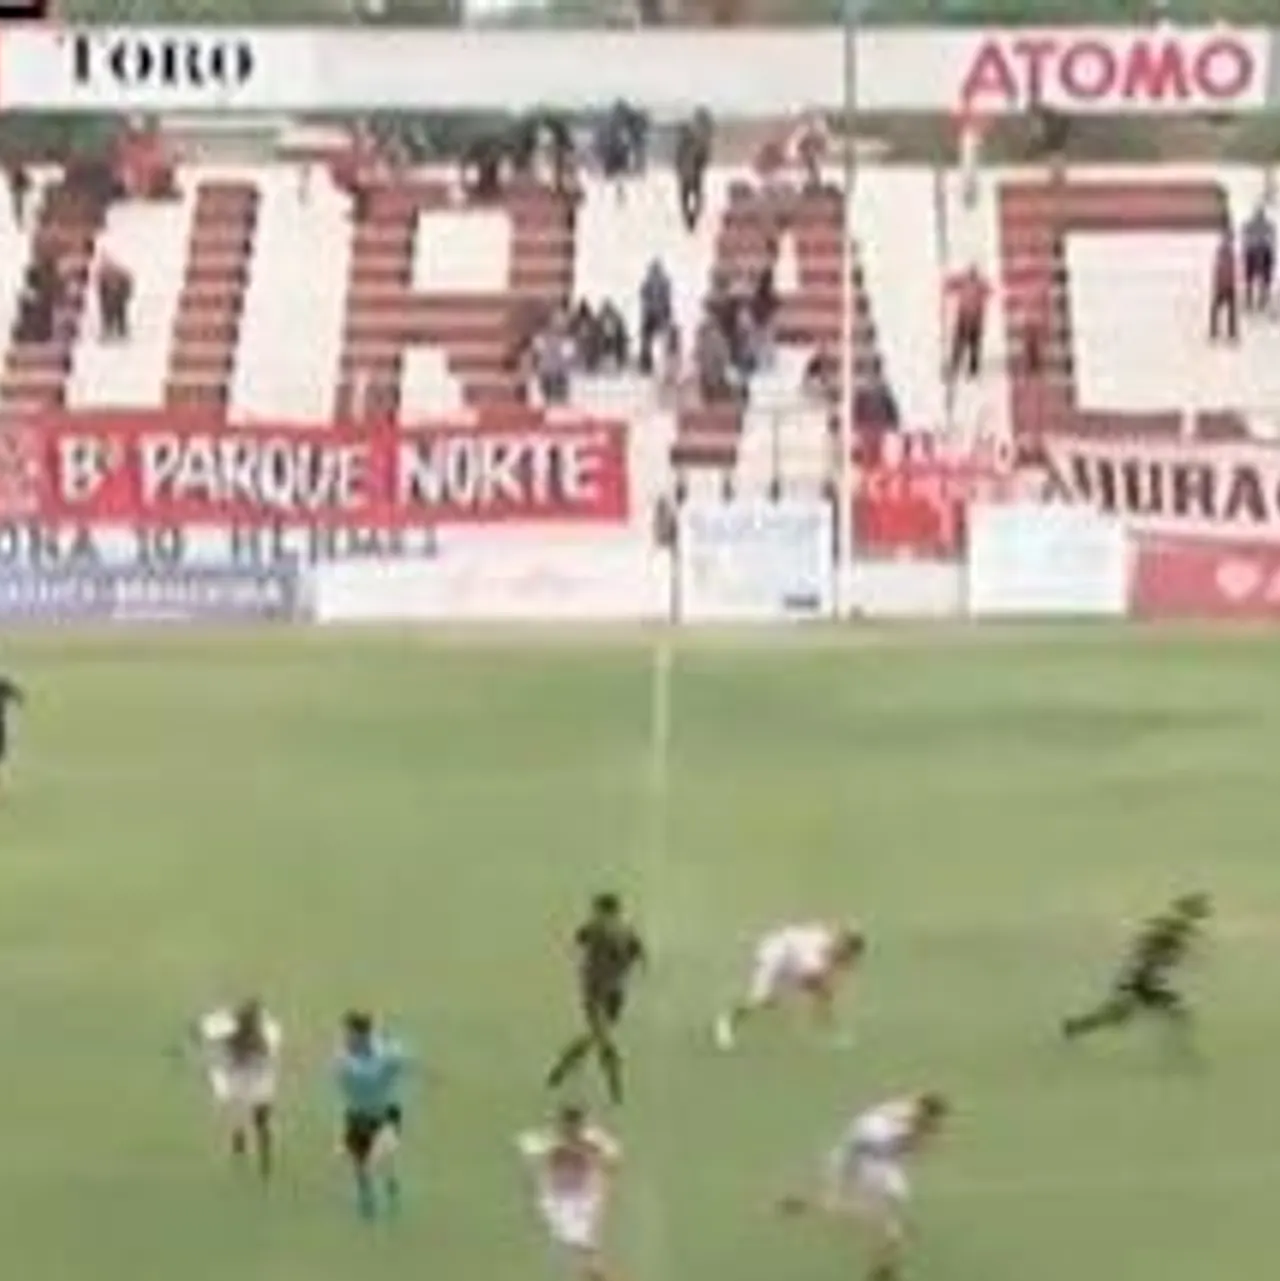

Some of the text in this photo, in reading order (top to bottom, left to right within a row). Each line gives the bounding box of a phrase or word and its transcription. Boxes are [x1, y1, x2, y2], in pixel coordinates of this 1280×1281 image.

[60, 33, 255, 87] TORO
[960, 37, 1255, 98] ATOMO
[140, 432, 370, 506] PARQUE
[400, 432, 608, 502] NORTE
